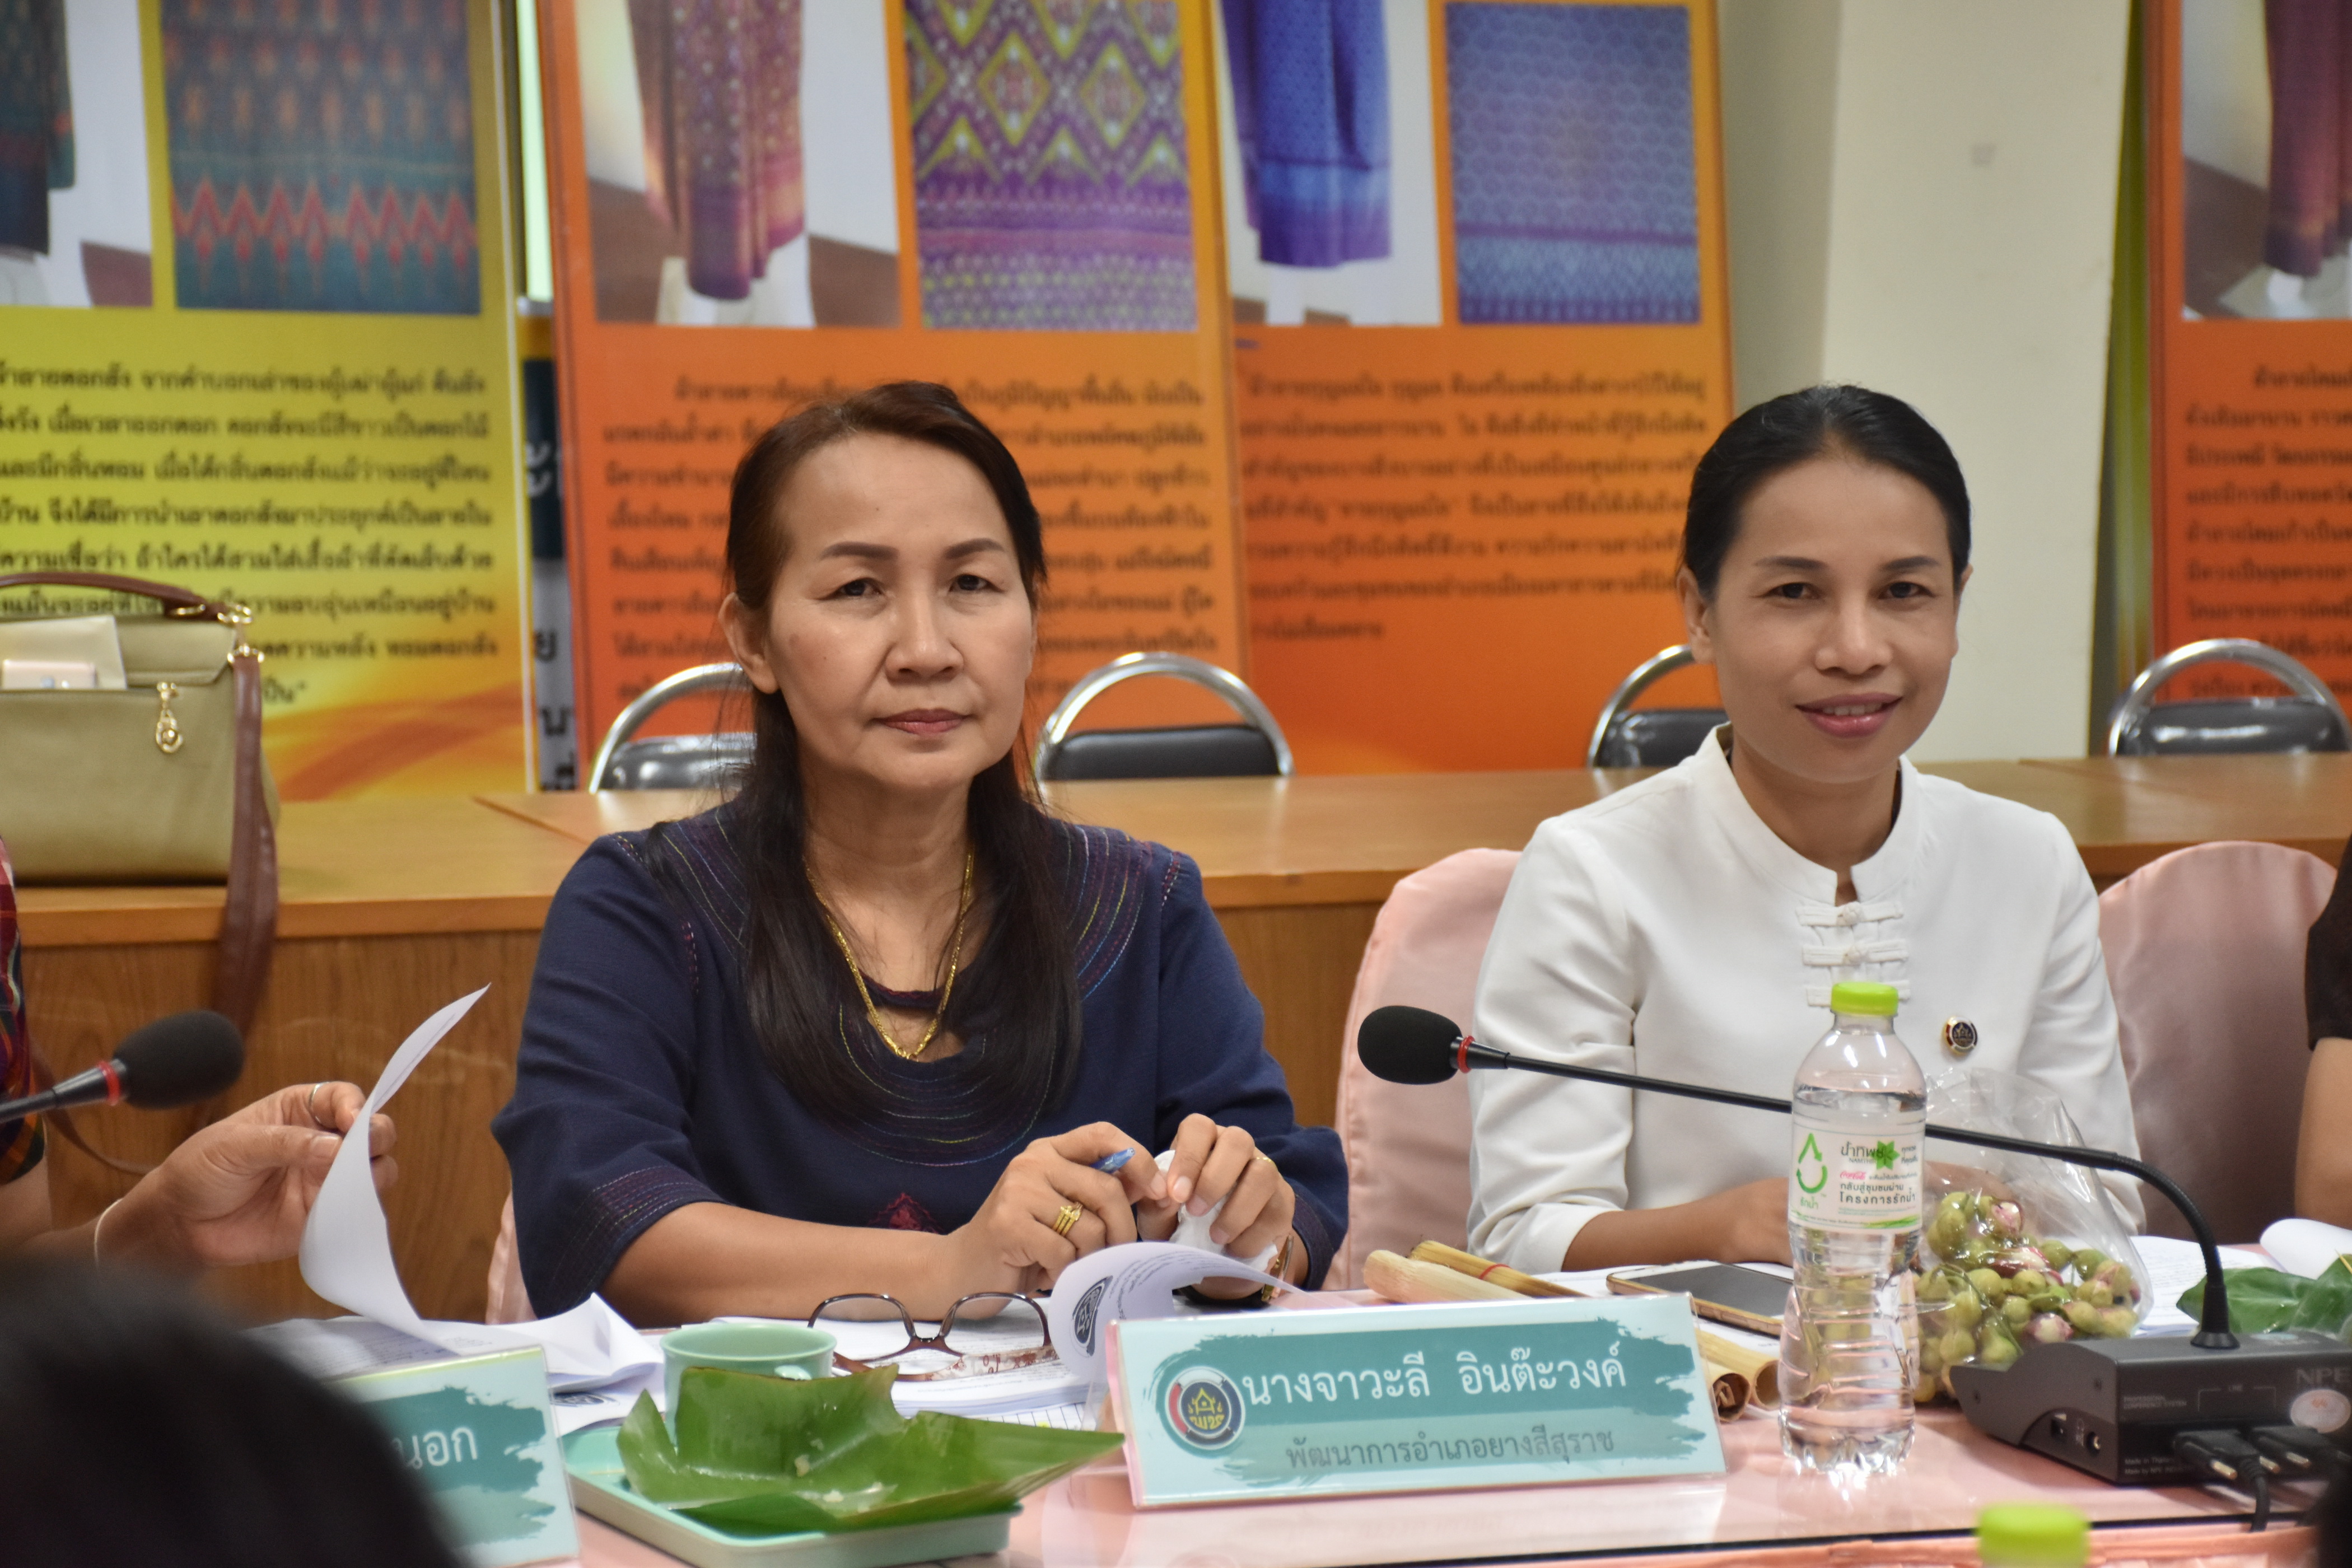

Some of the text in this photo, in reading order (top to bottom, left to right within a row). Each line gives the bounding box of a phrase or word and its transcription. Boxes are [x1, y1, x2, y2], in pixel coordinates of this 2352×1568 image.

[1840, 1182, 1903, 1193] กลับสู่ชุมชนผ่าน
[1840, 1187, 1916, 1204] โครงการรักน้ำ
[1242, 1341, 1626, 1405] นางจาวะลี อินต๊ะวงค์
[1286, 1424, 1614, 1468] พัฒนาการอำเภอยางสีสุราช
